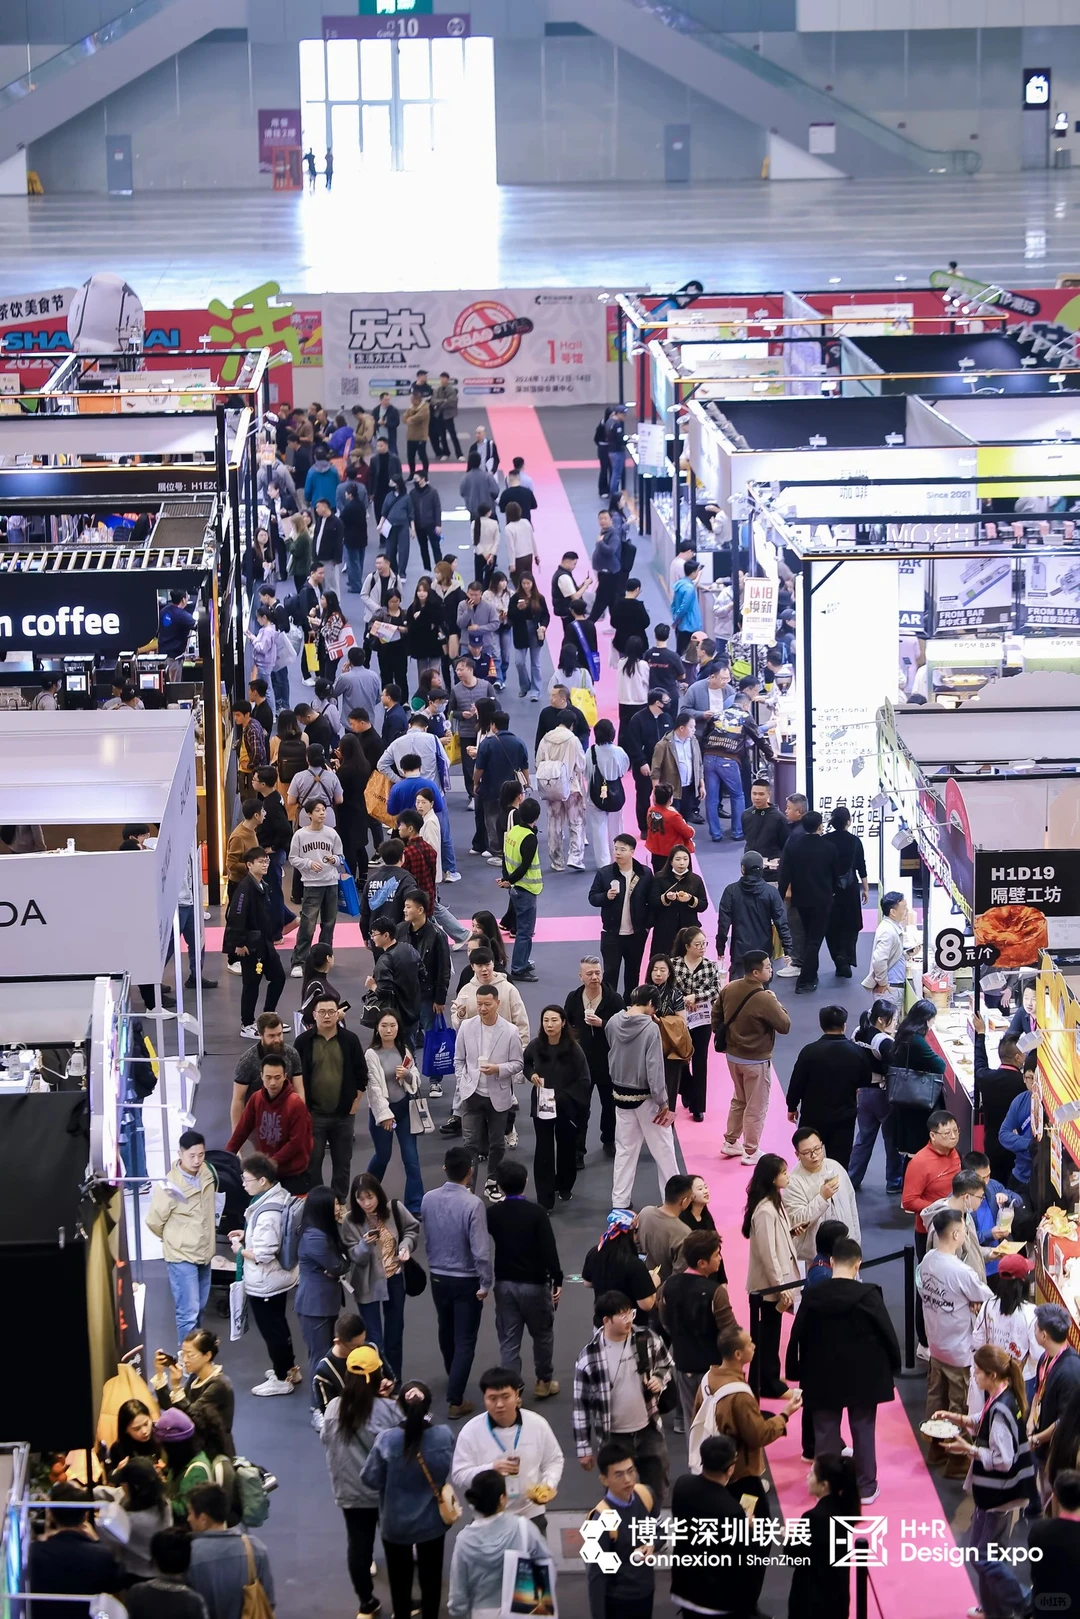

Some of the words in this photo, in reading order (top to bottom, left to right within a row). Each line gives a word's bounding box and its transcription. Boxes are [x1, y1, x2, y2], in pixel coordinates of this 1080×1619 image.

[398, 18, 419, 37] 10
[349, 309, 430, 350] 乐本
[927, 491, 948, 499] Since
[950, 491, 971, 499] 2021
[750, 586, 773, 599] 以旧
[750, 600, 773, 613] 换新
[1027, 608, 1056, 616] FROM
[1057, 608, 1077, 616] BAR
[22, 606, 120, 636] coffee
[939, 611, 966, 619] FROM
[967, 609, 985, 617] BAR
[991, 866, 1055, 881] H1D19
[991, 886, 1062, 905] 隔壁工坊
